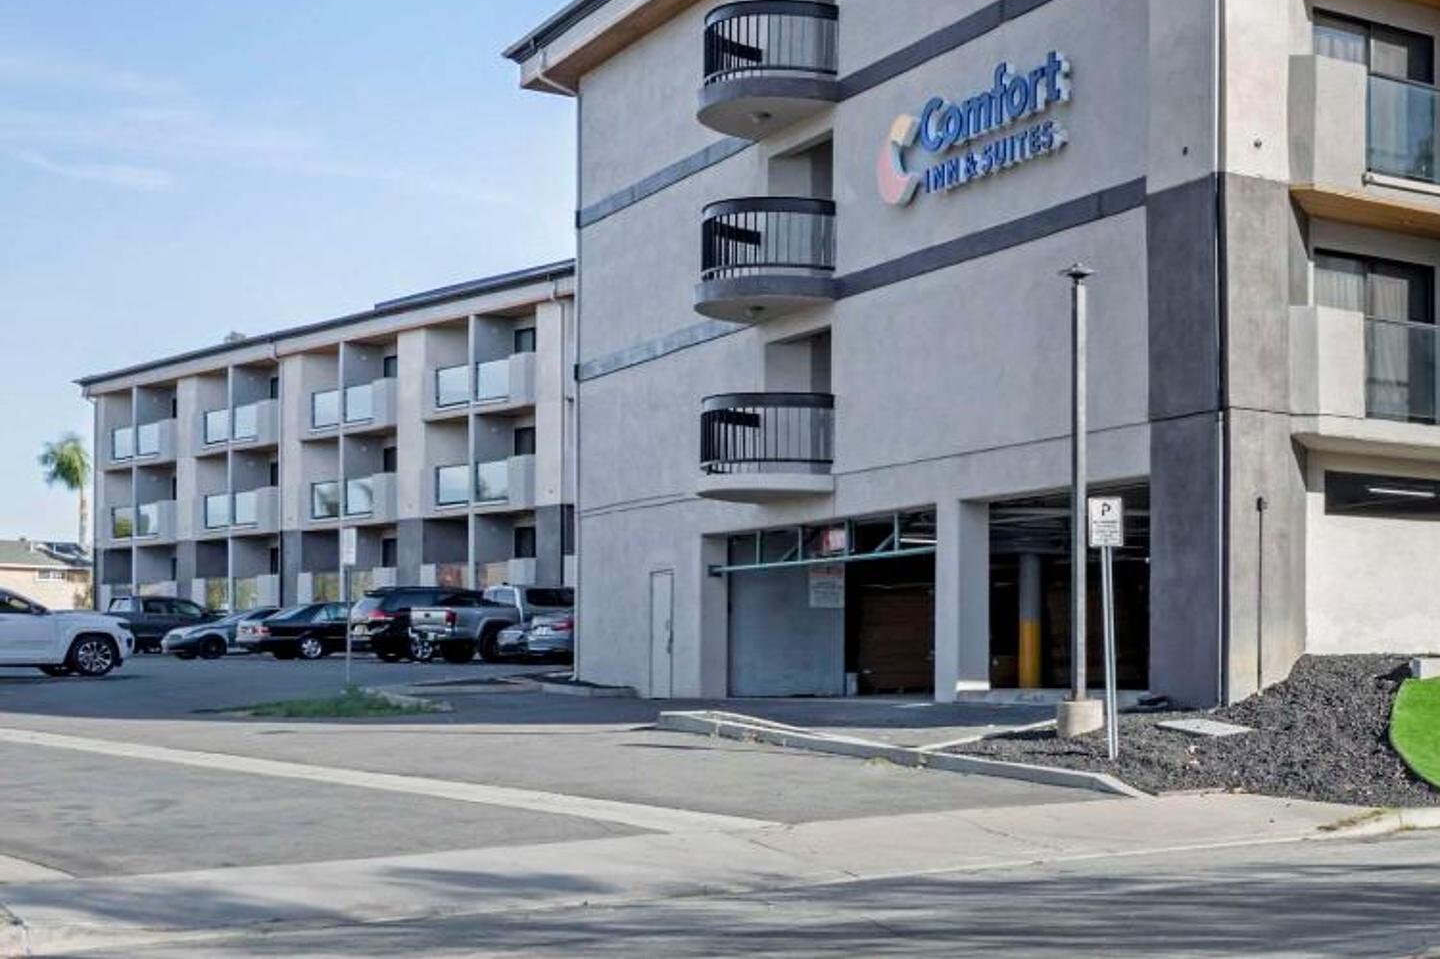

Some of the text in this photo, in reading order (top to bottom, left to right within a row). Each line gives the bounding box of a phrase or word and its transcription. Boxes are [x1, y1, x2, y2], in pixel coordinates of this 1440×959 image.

[920, 49, 1063, 153] Comfort
[924, 120, 1056, 193] INN & SUITES
